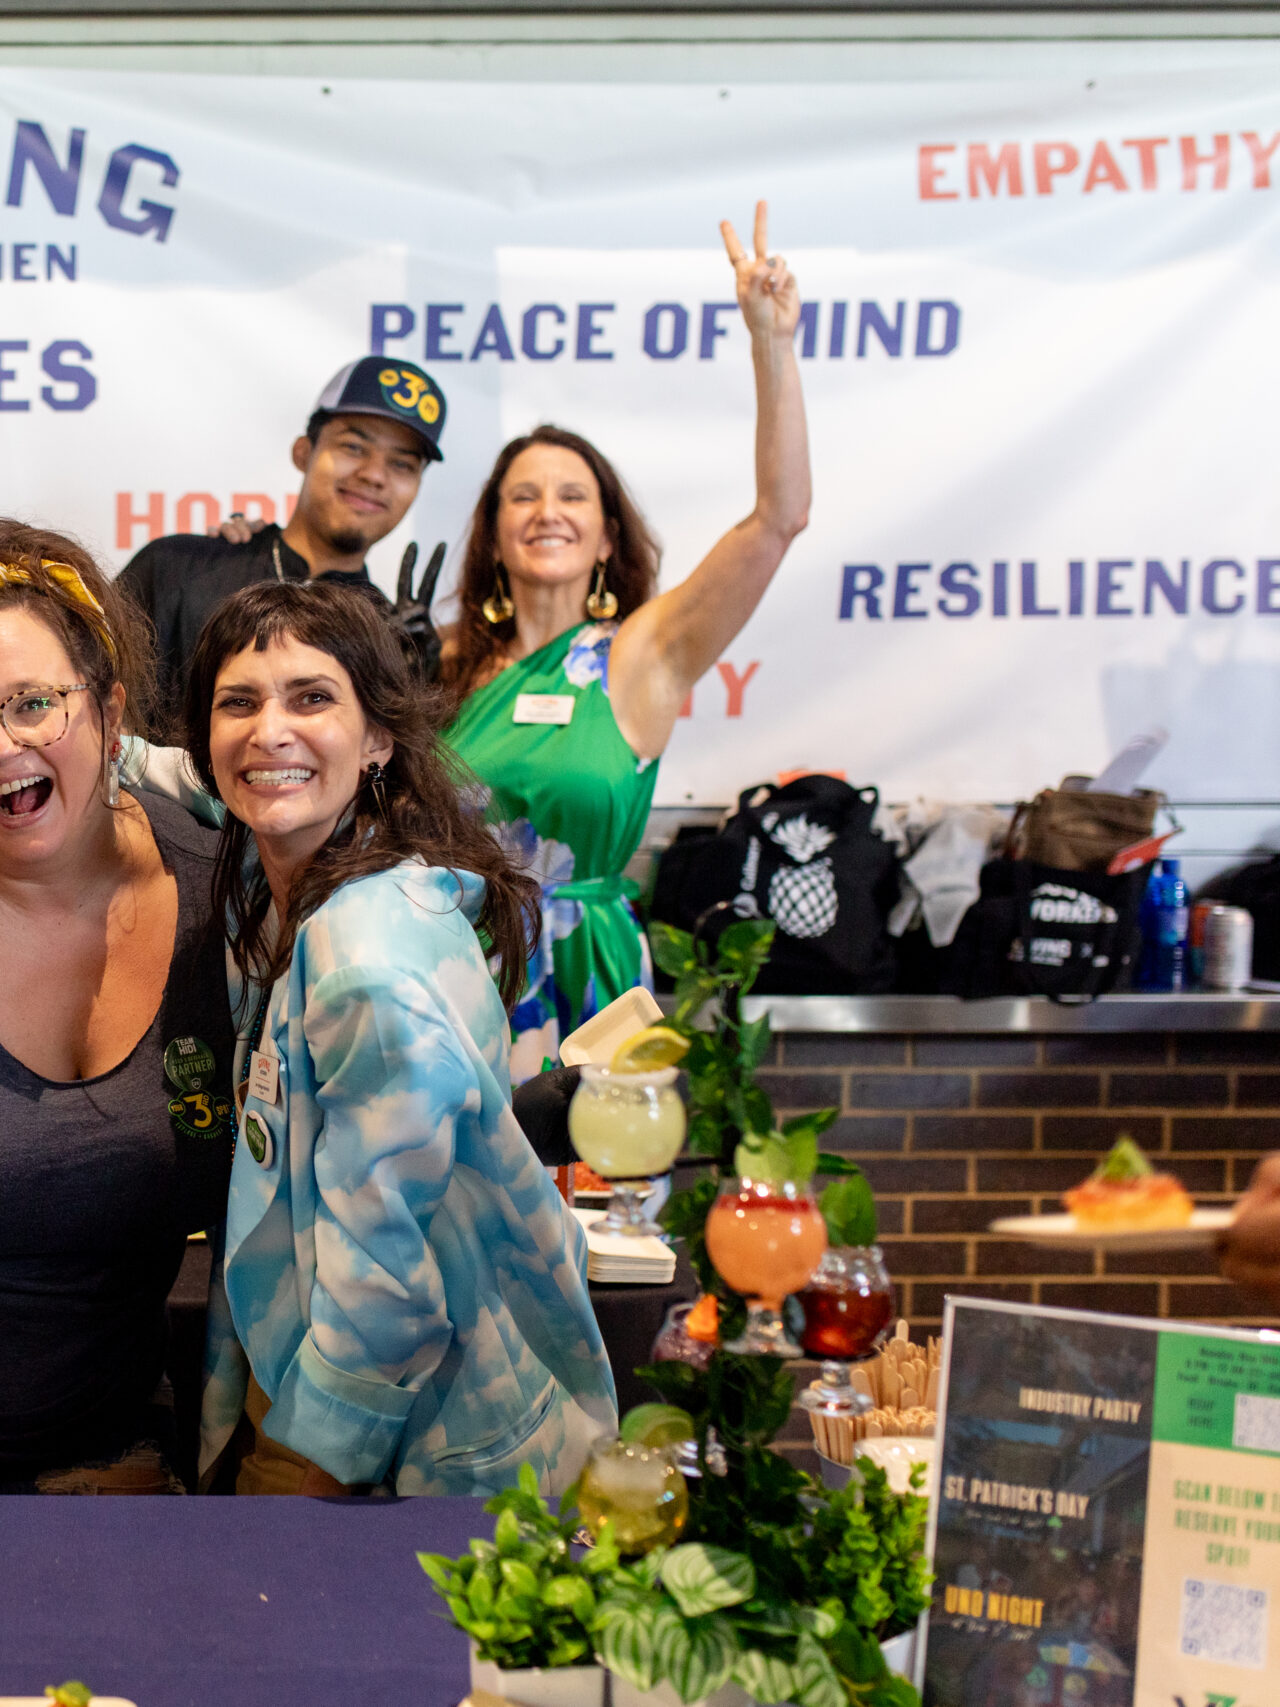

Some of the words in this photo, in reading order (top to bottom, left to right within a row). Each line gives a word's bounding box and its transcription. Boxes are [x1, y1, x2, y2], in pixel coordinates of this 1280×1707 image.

[919, 132, 1280, 200] EMPATHY
[371, 303, 615, 361] PEACE
[643, 303, 738, 360] OF
[392, 370, 428, 408] 3
[839, 559, 1280, 619] RESILIENCE
[175, 1037, 194, 1047] TEAM
[178, 1044, 197, 1055] HIDI
[171, 1059, 214, 1077] PARTNER
[183, 1093, 212, 1128] 3
[1019, 1386, 1093, 1418] INDUSTRY
[1093, 1396, 1142, 1425] PARTY
[970, 1478, 1054, 1515] PATRICK'S
[1055, 1491, 1090, 1520] DAY
[986, 1590, 1046, 1629] NIGHT
